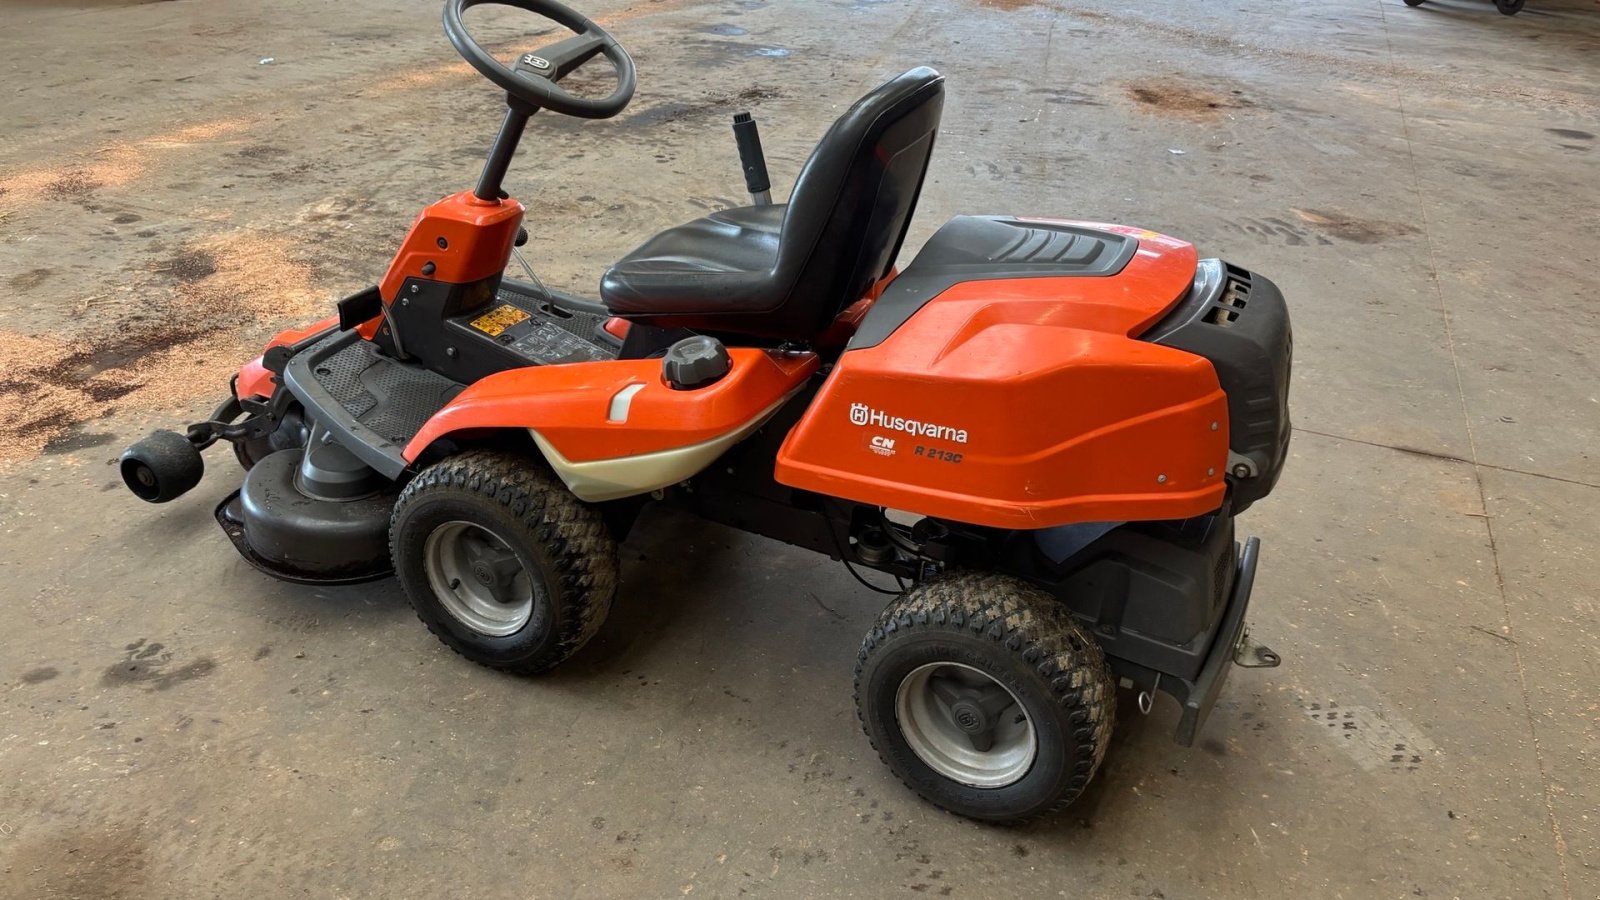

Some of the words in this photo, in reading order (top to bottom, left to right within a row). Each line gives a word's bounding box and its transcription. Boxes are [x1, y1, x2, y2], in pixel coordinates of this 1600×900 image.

[870, 409, 968, 443] Husqvarna
[871, 436, 895, 449] CN
[915, 446, 924, 456] R
[927, 448, 962, 463] 213C
